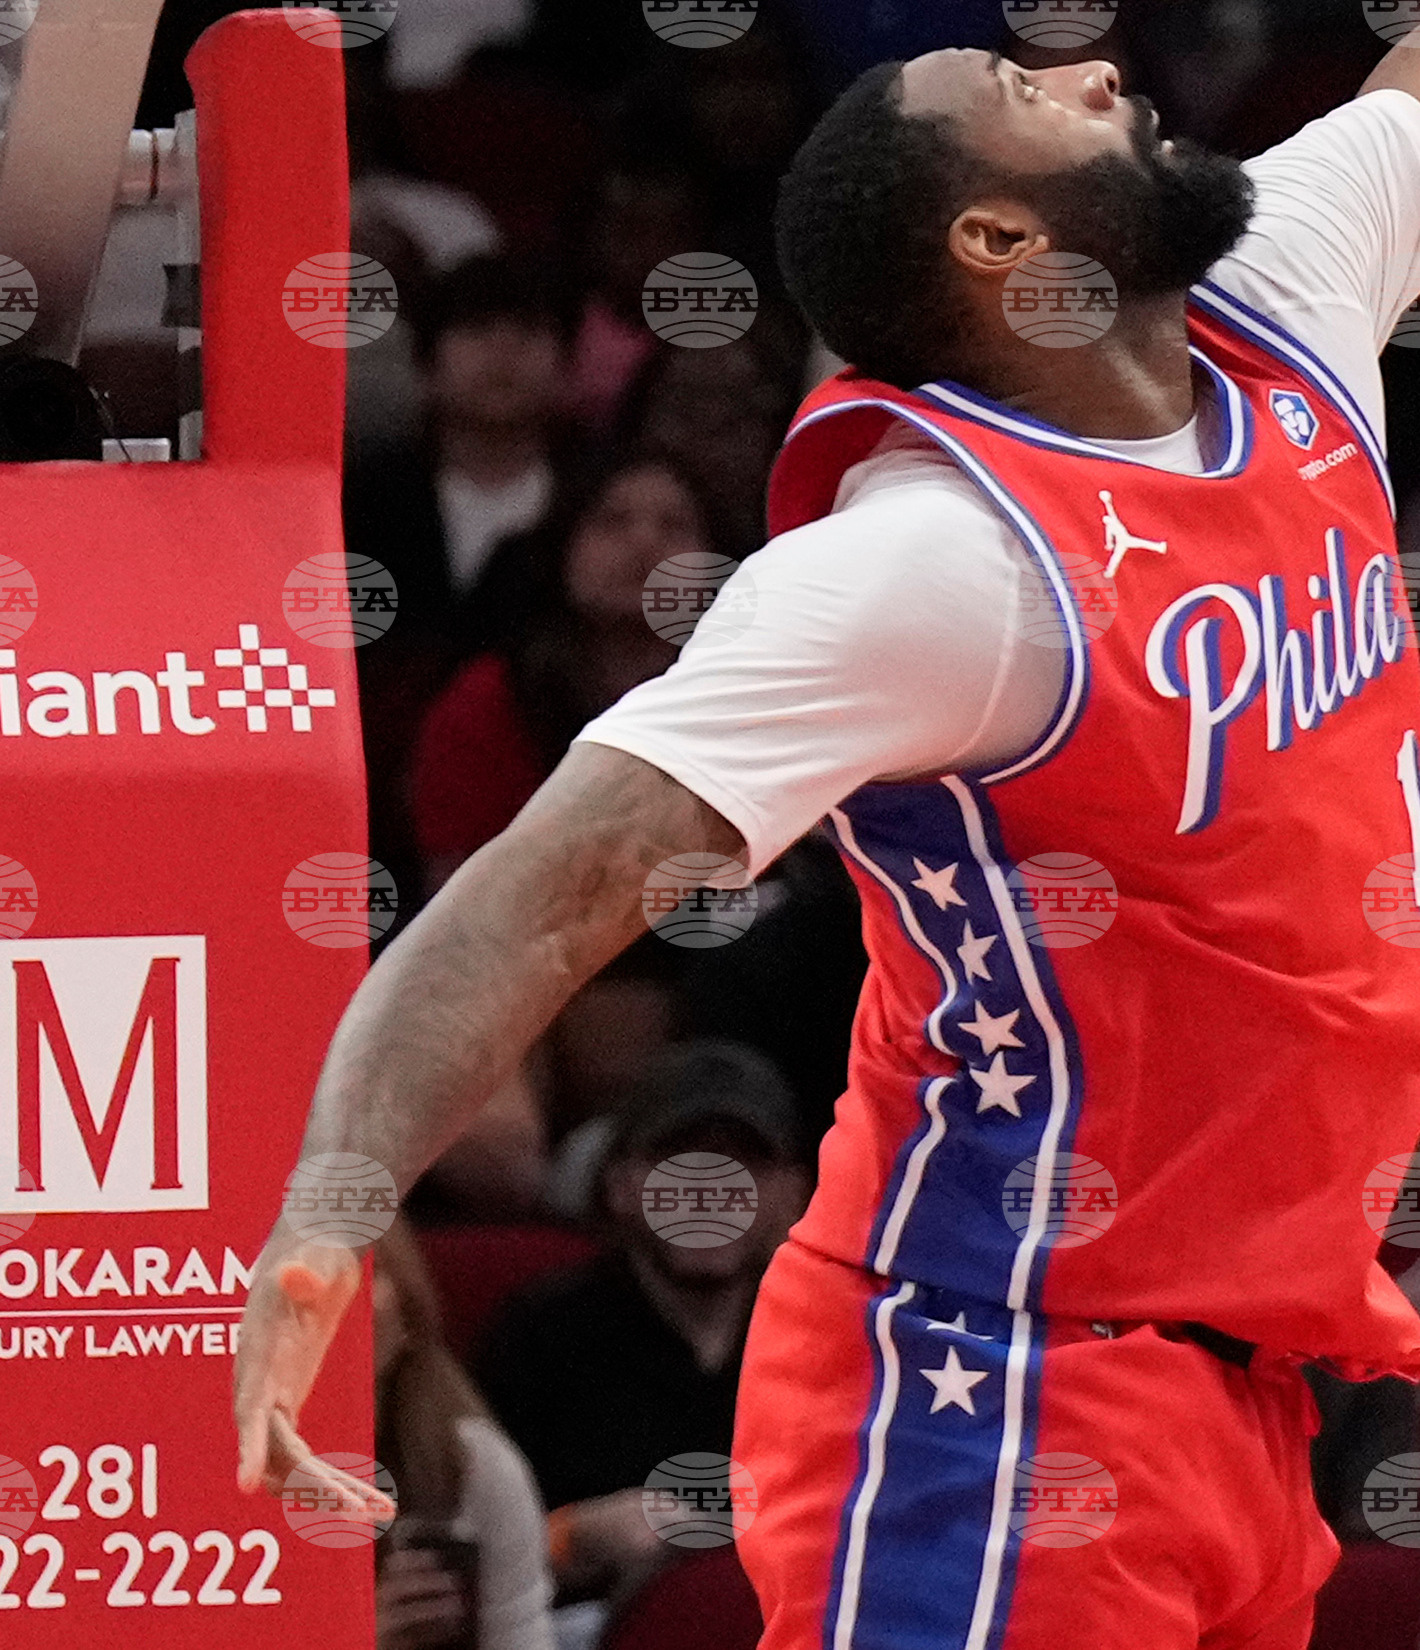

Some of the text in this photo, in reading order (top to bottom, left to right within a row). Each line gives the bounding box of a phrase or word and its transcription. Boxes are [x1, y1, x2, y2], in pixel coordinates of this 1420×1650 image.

[0, 649, 216, 738] iant
[1145, 527, 1405, 835] Phila
[12, 956, 183, 1192] M
[39, 1443, 158, 1521] 281
